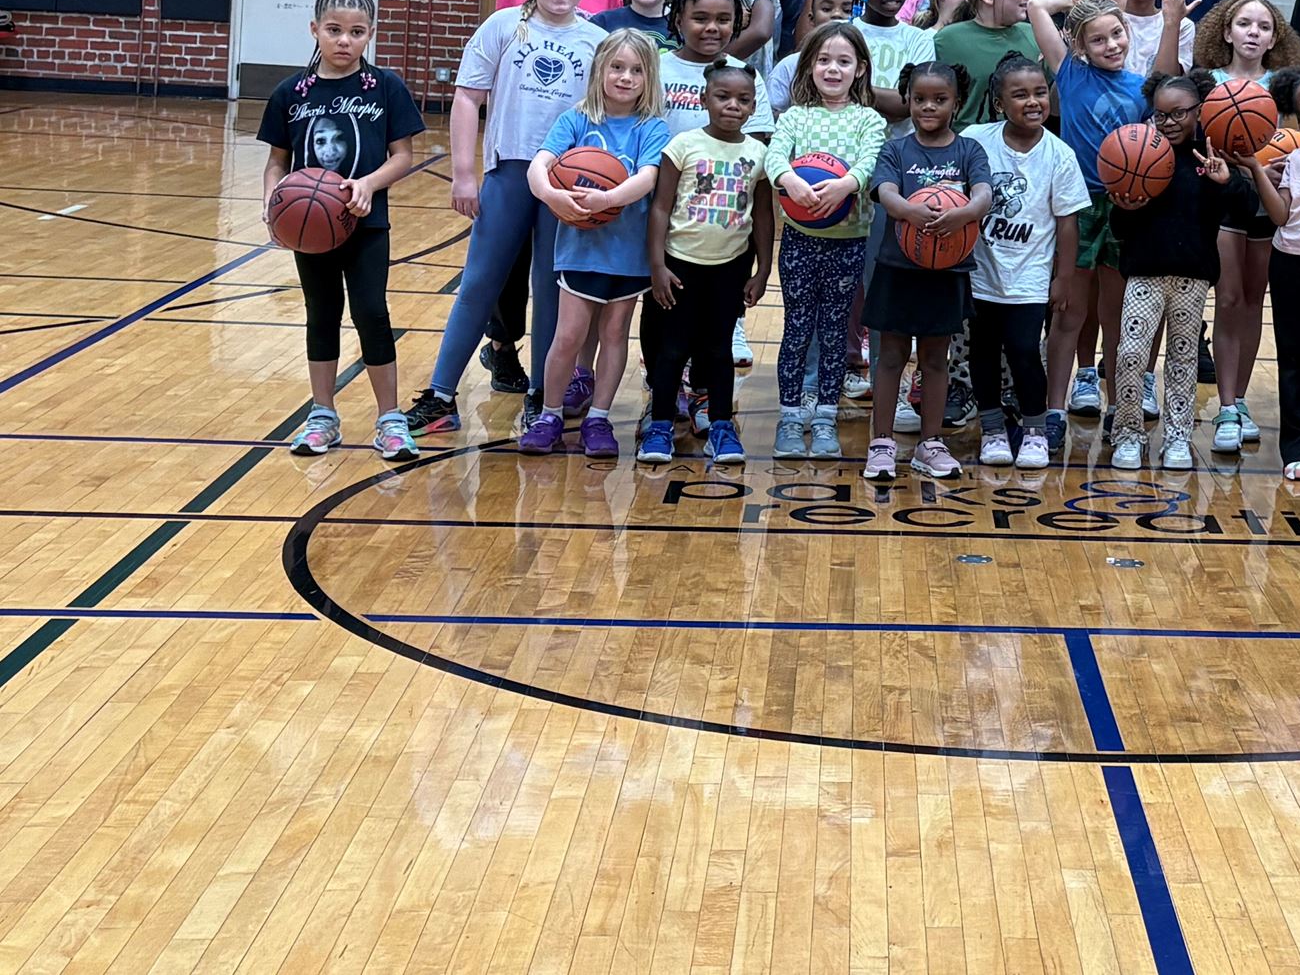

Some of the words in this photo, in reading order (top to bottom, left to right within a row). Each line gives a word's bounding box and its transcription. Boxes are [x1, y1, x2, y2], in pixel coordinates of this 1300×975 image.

[513, 42, 539, 69] ALL
[543, 40, 584, 81] HEART
[664, 83, 706, 95] VIRGI
[288, 102, 326, 123] Alexis
[329, 96, 384, 122] Murphy
[664, 99, 706, 111] ATHLE
[696, 159, 742, 177] GIRLS
[906, 163, 926, 175] Los
[927, 165, 960, 179] Angeles
[990, 217, 1034, 243] RUN
[662, 480, 1042, 507] parks
